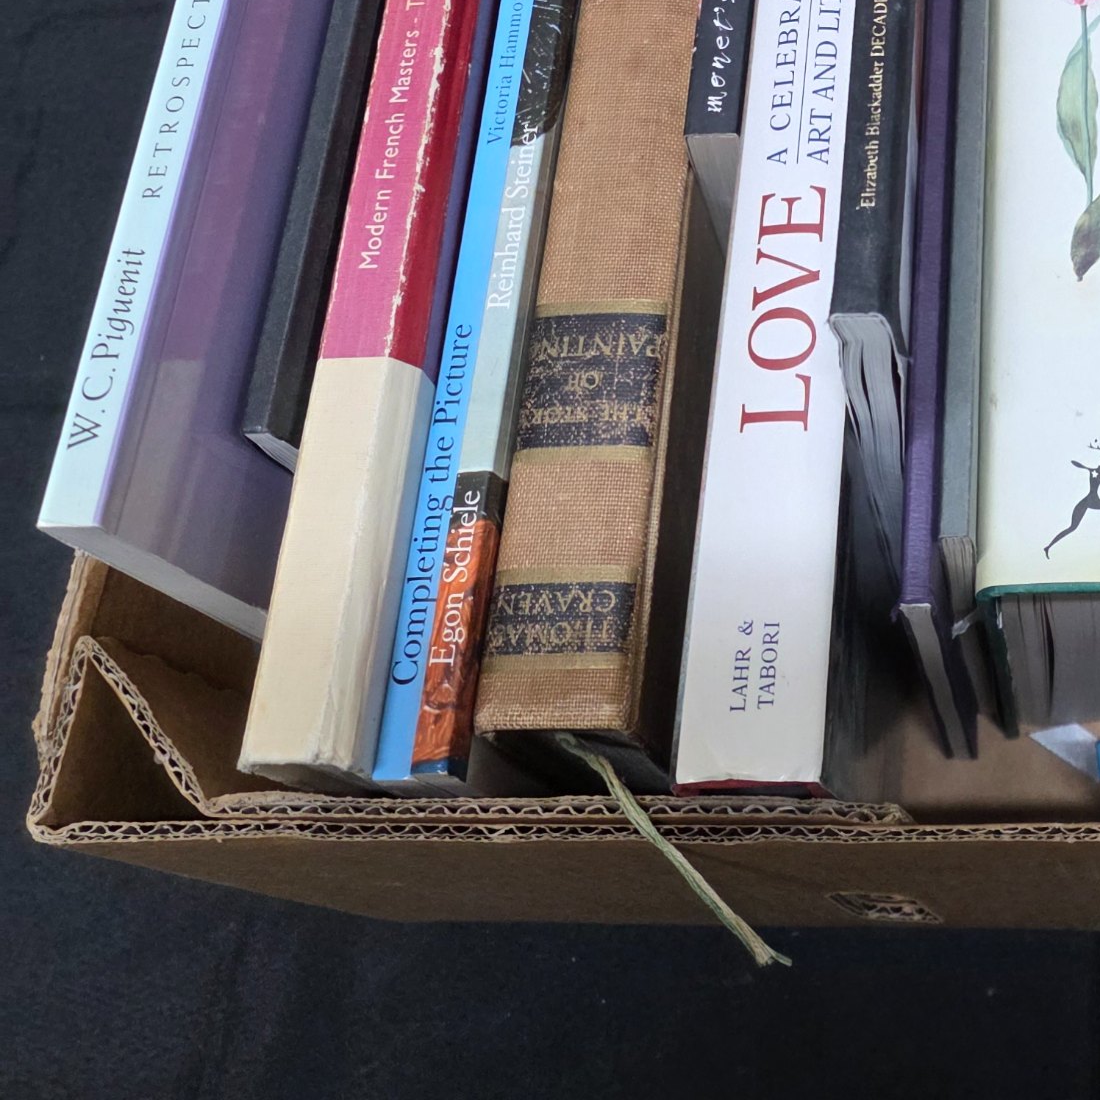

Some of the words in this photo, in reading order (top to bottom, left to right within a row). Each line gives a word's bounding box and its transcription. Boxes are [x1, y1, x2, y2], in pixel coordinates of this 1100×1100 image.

[390, 27, 419, 103] Masters
[812, 33, 840, 102] AND
[865, 60, 885, 135] Blackadder
[376, 112, 405, 182] French
[487, 74, 513, 145] Victoria
[804, 105, 832, 165] ART
[505, 122, 538, 198] Steiner
[767, 144, 788, 166] A
[860, 140, 880, 208] Elizabeth
[359, 187, 391, 269] Modern
[487, 205, 526, 309] Reinhard
[739, 183, 828, 433] LOVE
[434, 324, 473, 426] Picture
[426, 435, 454, 488] the
[443, 489, 481, 584] Schiele
[392, 496, 454, 685] Completing
[429, 581, 474, 667] Egon
[496, 589, 616, 615] CRAVEN
[738, 620, 754, 635] &
[730, 647, 751, 712] LAHR
[757, 622, 780, 709] TABORI
